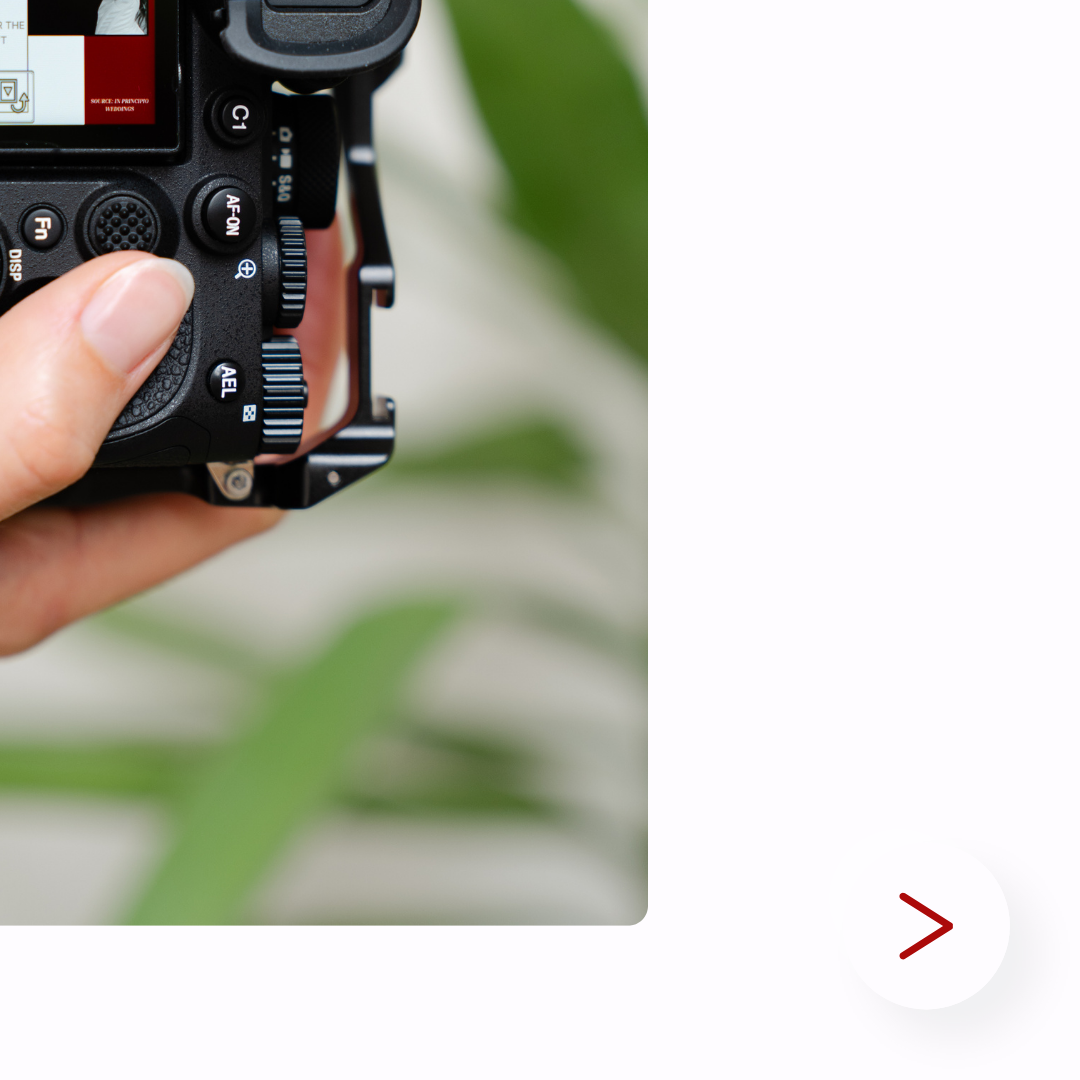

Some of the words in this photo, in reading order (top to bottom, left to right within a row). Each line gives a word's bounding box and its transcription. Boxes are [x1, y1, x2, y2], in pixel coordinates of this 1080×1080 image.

[5, 20, 25, 30] THE
[231, 104, 250, 130] C1
[34, 217, 52, 240] Fn
[224, 193, 241, 237] AF-ON
[9, 248, 23, 282] DISP
[220, 364, 238, 399] AEL
